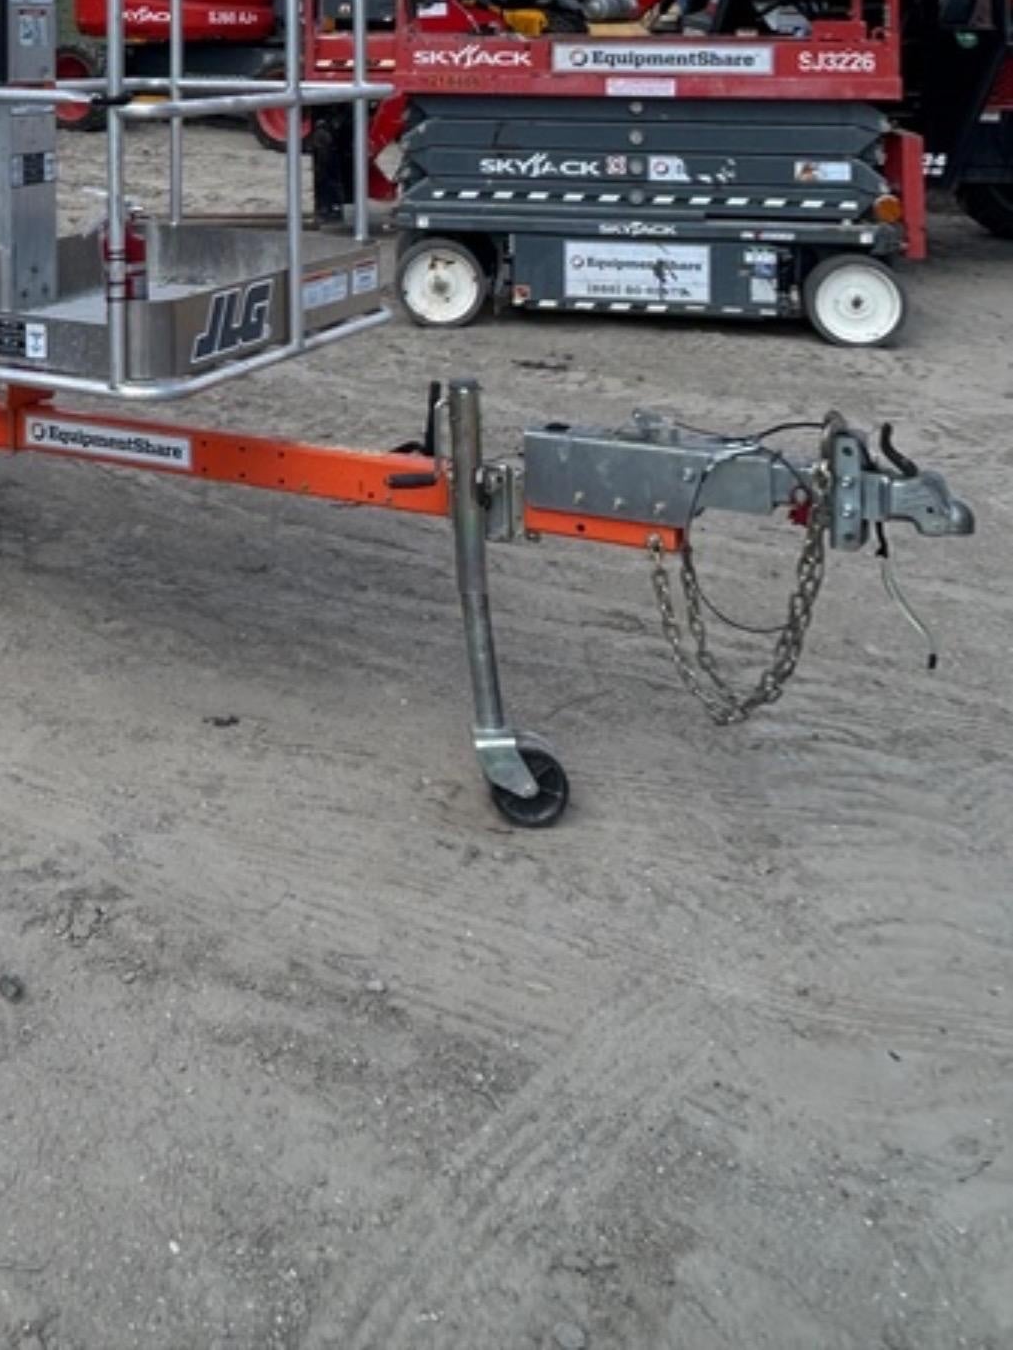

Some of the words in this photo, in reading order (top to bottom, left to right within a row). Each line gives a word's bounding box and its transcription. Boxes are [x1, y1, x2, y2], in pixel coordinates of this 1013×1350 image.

[413, 45, 532, 68] SKYJACK
[592, 51, 755, 68] EquipmentShare
[799, 52, 876, 72] SJ3226
[480, 153, 600, 177] SKYJACK
[599, 222, 676, 236] SKYJACK
[193, 279, 273, 363] JLG
[47, 425, 183, 459] EquipmentShare
